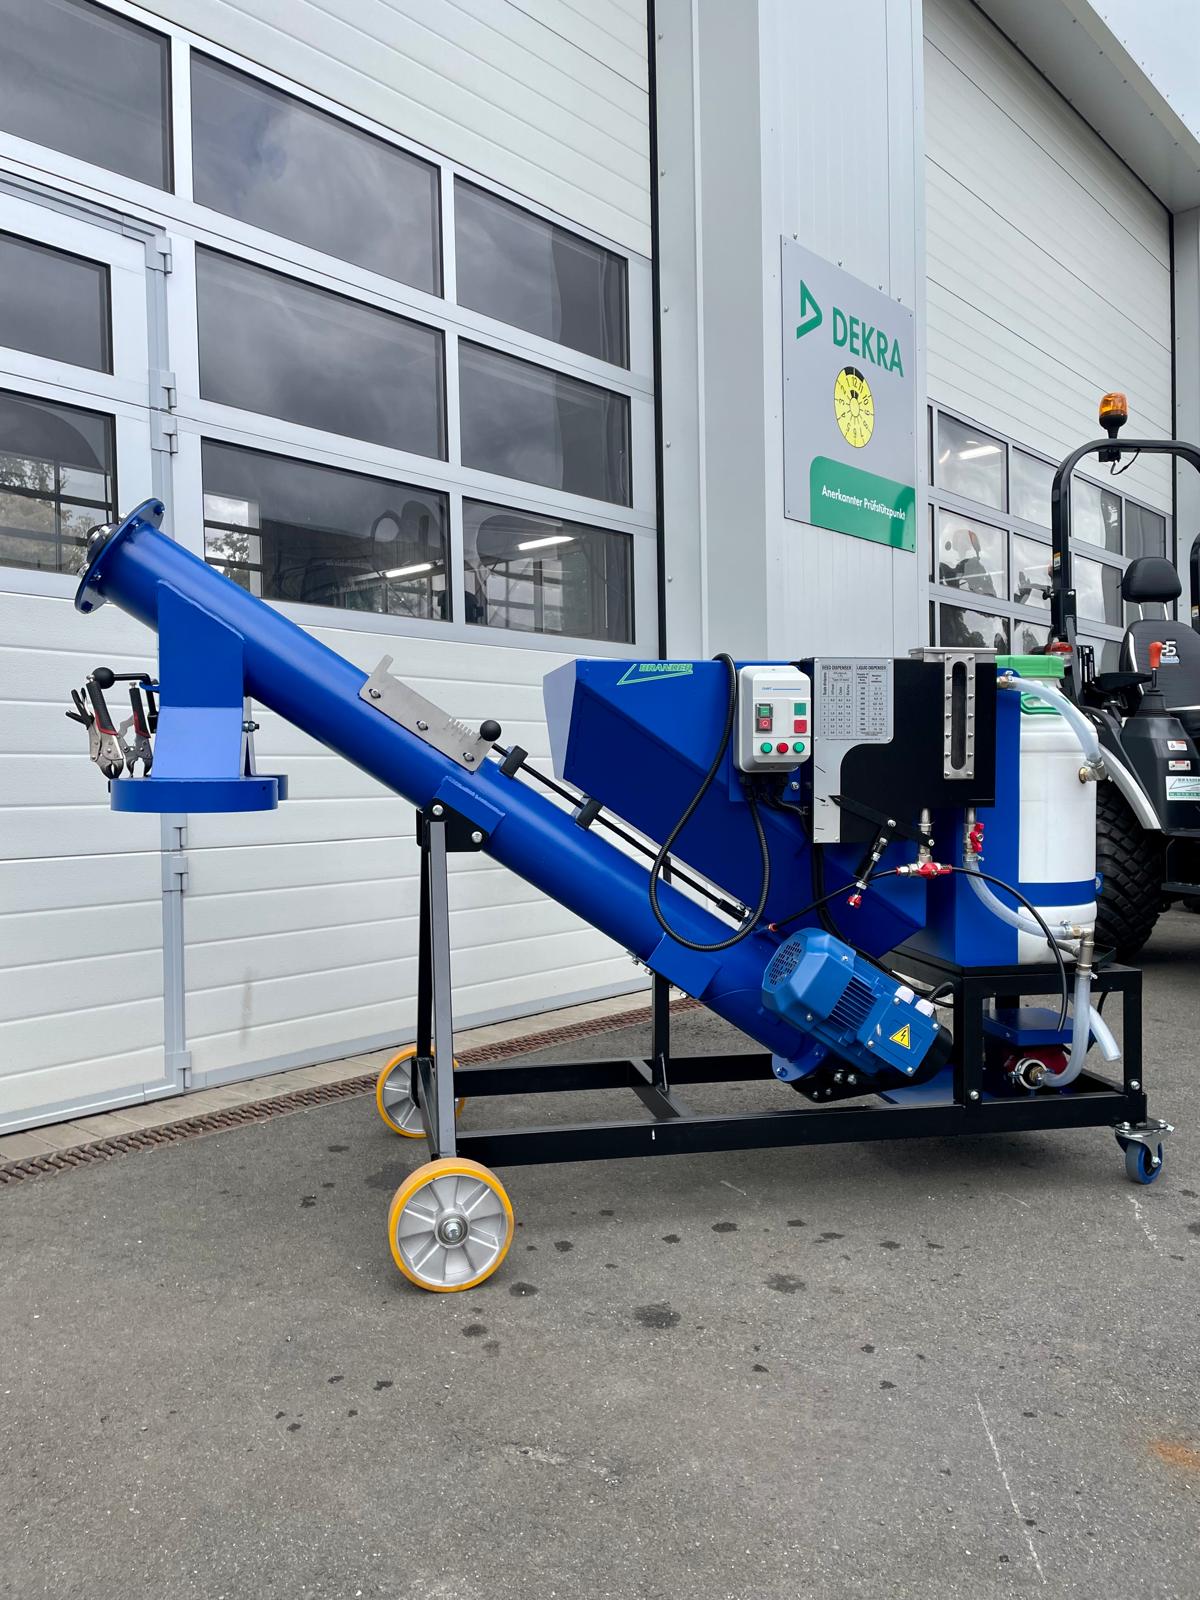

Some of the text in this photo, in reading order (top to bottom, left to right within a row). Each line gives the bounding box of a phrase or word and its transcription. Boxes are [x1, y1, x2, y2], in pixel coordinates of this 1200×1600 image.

[833, 306, 904, 378] DEKRA
[822, 485, 906, 521] Anerkannter Prüfstützpunkt
